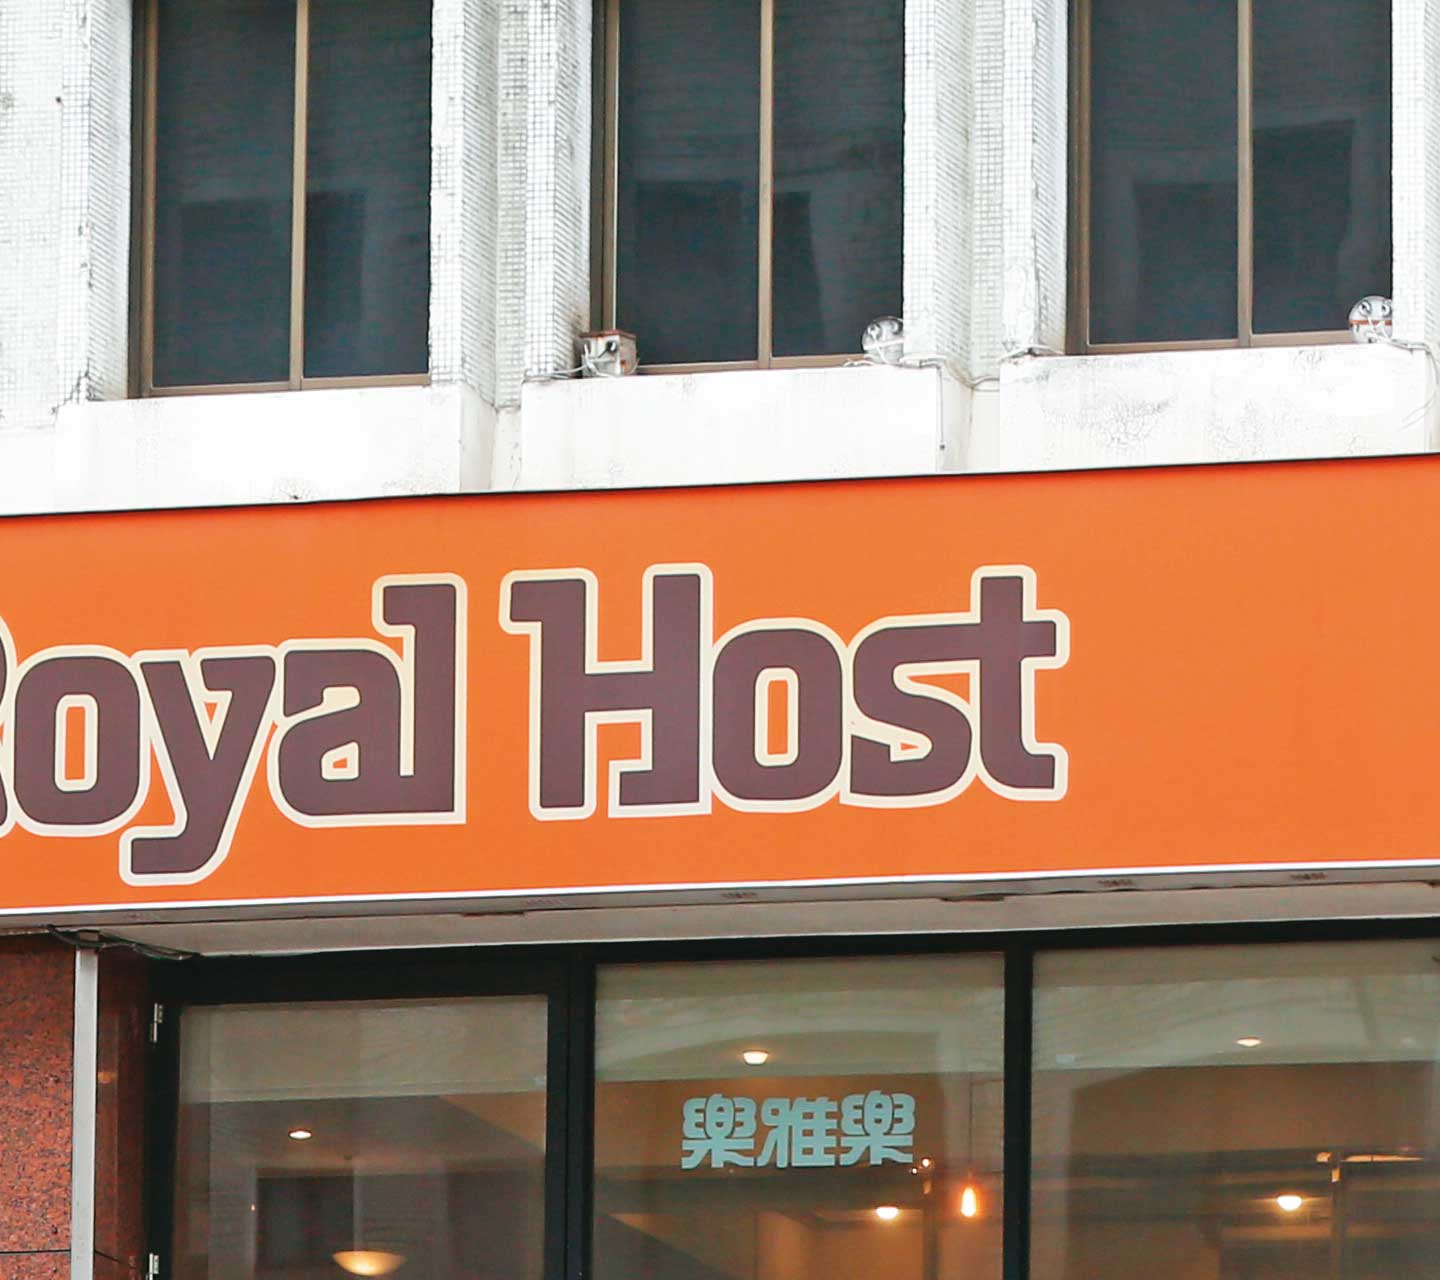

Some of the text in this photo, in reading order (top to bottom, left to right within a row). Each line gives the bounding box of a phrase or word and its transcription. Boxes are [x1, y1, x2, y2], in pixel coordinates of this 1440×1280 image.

[499, 563, 1070, 820] Host
[681, 1090, 916, 1170] 樂雅樂
